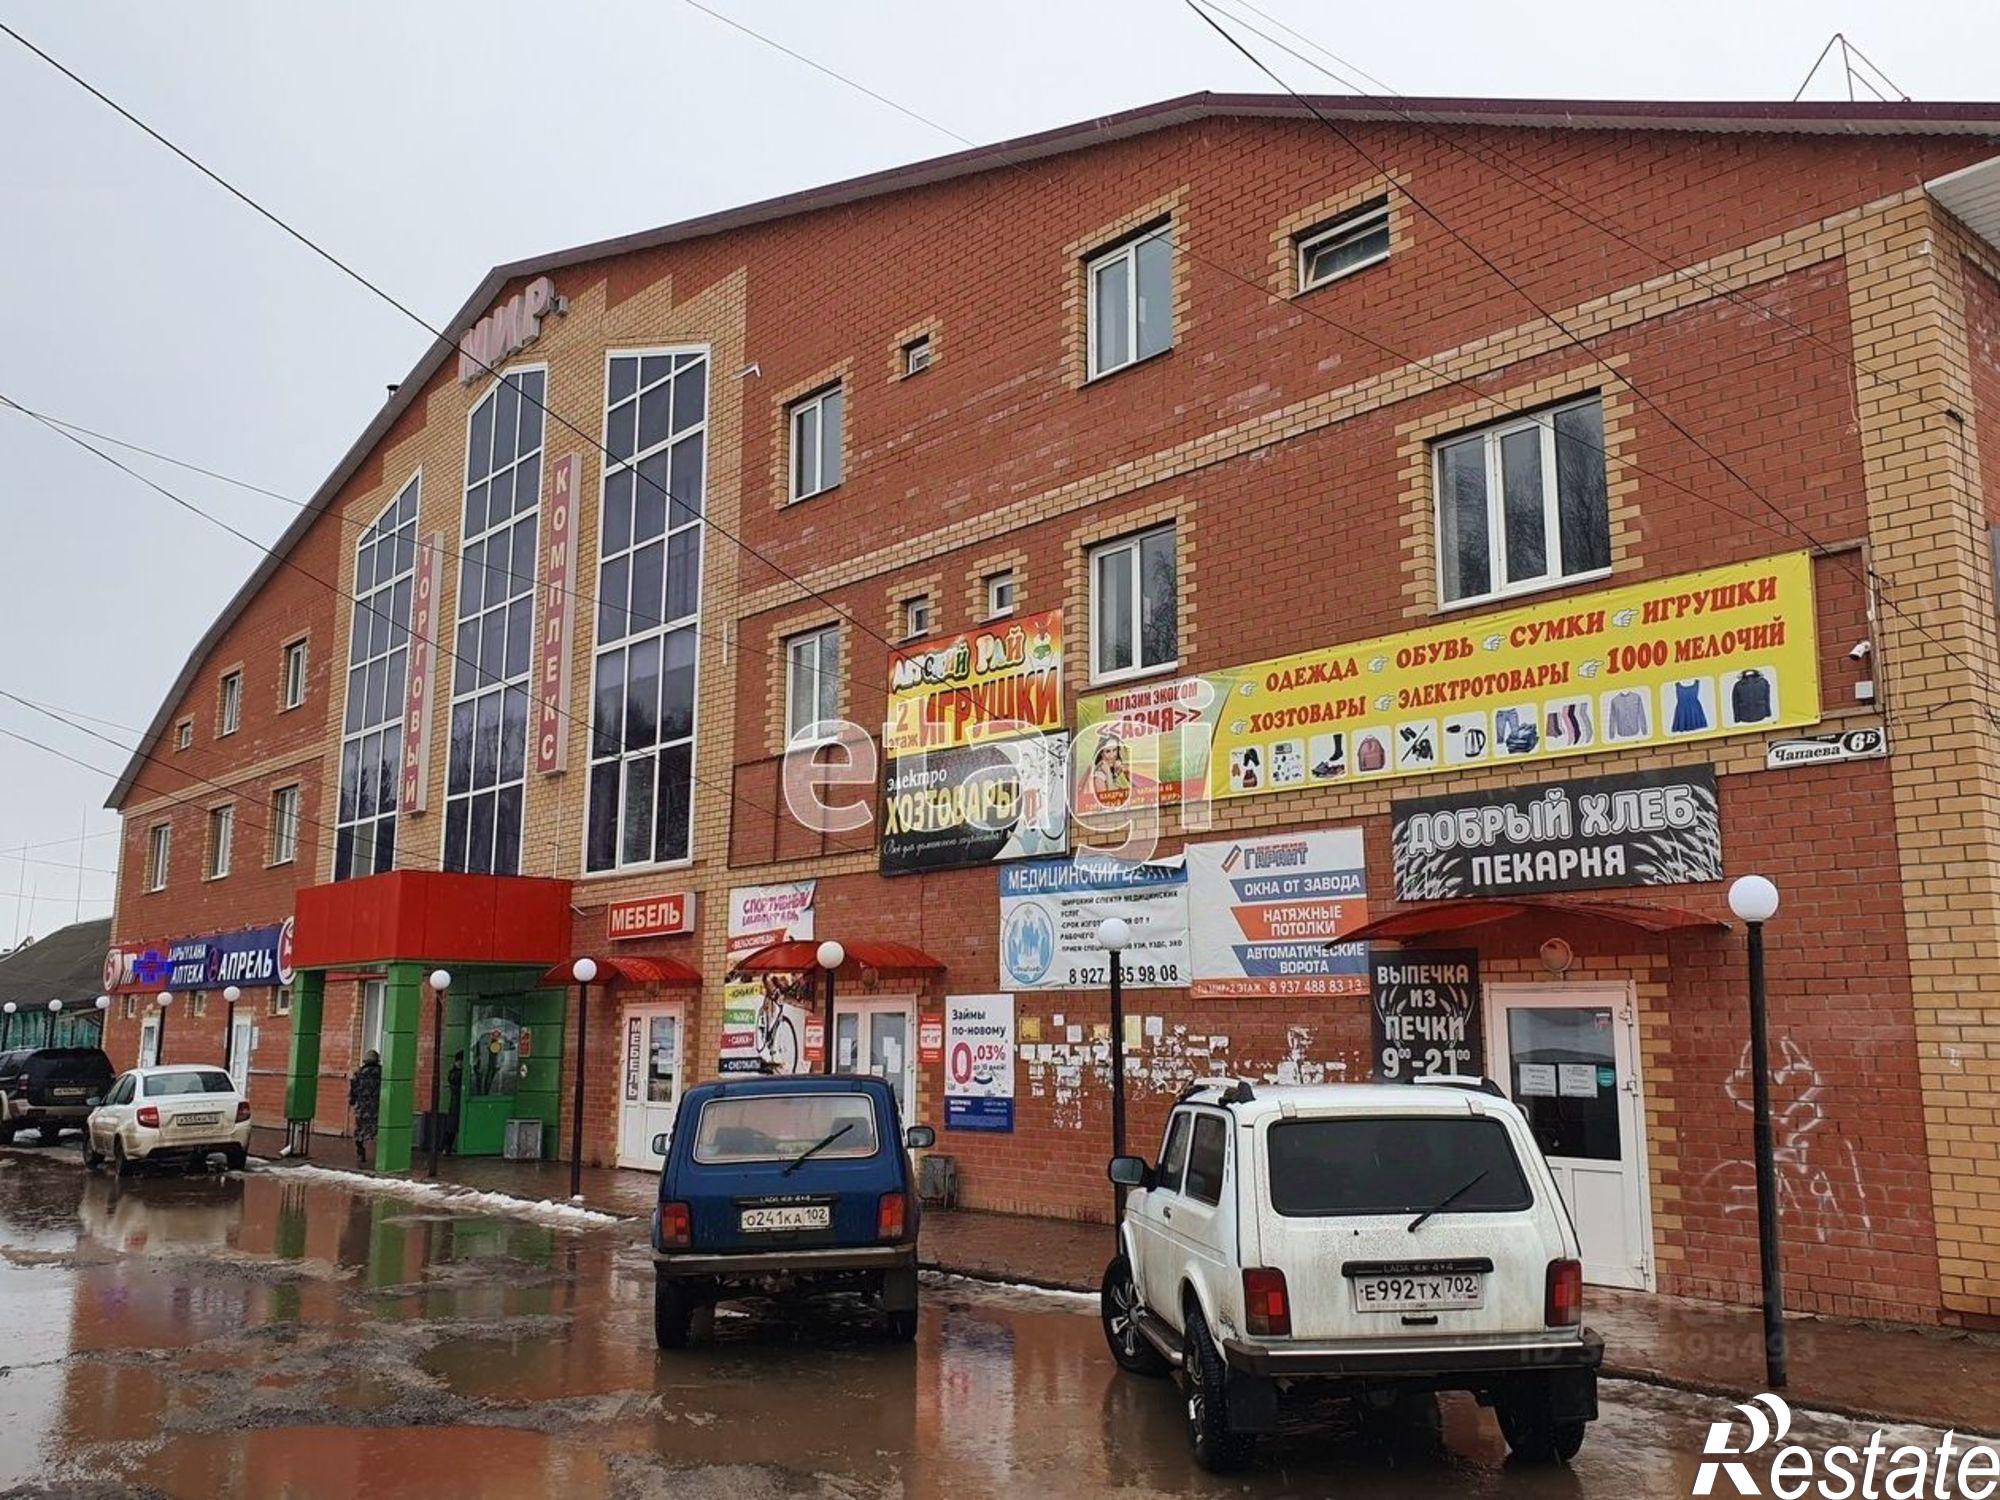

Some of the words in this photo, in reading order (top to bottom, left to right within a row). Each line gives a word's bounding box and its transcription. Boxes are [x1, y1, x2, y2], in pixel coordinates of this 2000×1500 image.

[541, 470, 568, 763] КОМПЛЕКС
[1266, 658, 1359, 692] ОДЕЖДА
[1396, 637, 1474, 668] ОБУВЬ
[1510, 611, 1605, 648] СУМКИ
[1641, 577, 1778, 625] ИГРУШКИ
[975, 624, 1026, 675] РАЙ
[404, 541, 434, 804] ТОРГОВЫЙ
[1249, 696, 1366, 733] ХОЗТОВАРЫ
[1398, 661, 1569, 709] ЭЛЕКТРОТОВАРЫ
[1606, 640, 1669, 674] 1000
[1674, 615, 1785, 663] МЕЛОЧИЙ
[918, 666, 1058, 749] ИГРУШКИ
[1105, 692, 1151, 714] МАГАЗИН
[896, 702, 910, 731] 2
[1775, 745, 1840, 761] Чапаева
[885, 766, 948, 792] электро
[885, 776, 1018, 836] ХОЗТОВАРЫ
[1408, 788, 1572, 857] ДОБРЫЙ
[1580, 784, 1697, 836] ХЛЕБ
[1471, 845, 1626, 886] ПЕКАРНЯ
[1244, 879, 1279, 896] ОКНА
[1283, 879, 1299, 893] ОТ
[1304, 874, 1361, 891] ЗАВОДА
[612, 902, 680, 931] МЕБЕЛЬ
[1263, 905, 1342, 923] НАТЯЖНЫЕ
[1271, 921, 1336, 937] ПОТОЛКИ
[1247, 943, 1365, 960] АВТОМАТИЧЕСКИЕ
[170, 963, 204, 984] АПТЕКА
[217, 948, 272, 981] АПРЕЛЬ
[1069, 968, 1077, 984] 8
[1080, 966, 1104, 984] 927
[1138, 965, 1155, 982] 98
[1160, 965, 1177, 982] 08
[1280, 960, 1329, 974] ВОРОТА
[1377, 965, 1469, 985] ВЫПЕЧКА
[1269, 981, 1276, 994] 8
[1280, 980, 1300, 994] 937
[1304, 980, 1324, 993] 488
[1329, 980, 1344, 993] 83
[1410, 988, 1436, 1008] ИЗ
[952, 1008, 986, 1021] Займы
[952, 1025, 1006, 1038] по-новому
[1385, 1016, 1465, 1041] ПЕЧКИ
[628, 1018, 642, 1097] МЕБЕЛЬ
[806, 1208, 826, 1220] 102
[1365, 1279, 1442, 1301] Е992ТХ
[1444, 1277, 1474, 1292] 702
